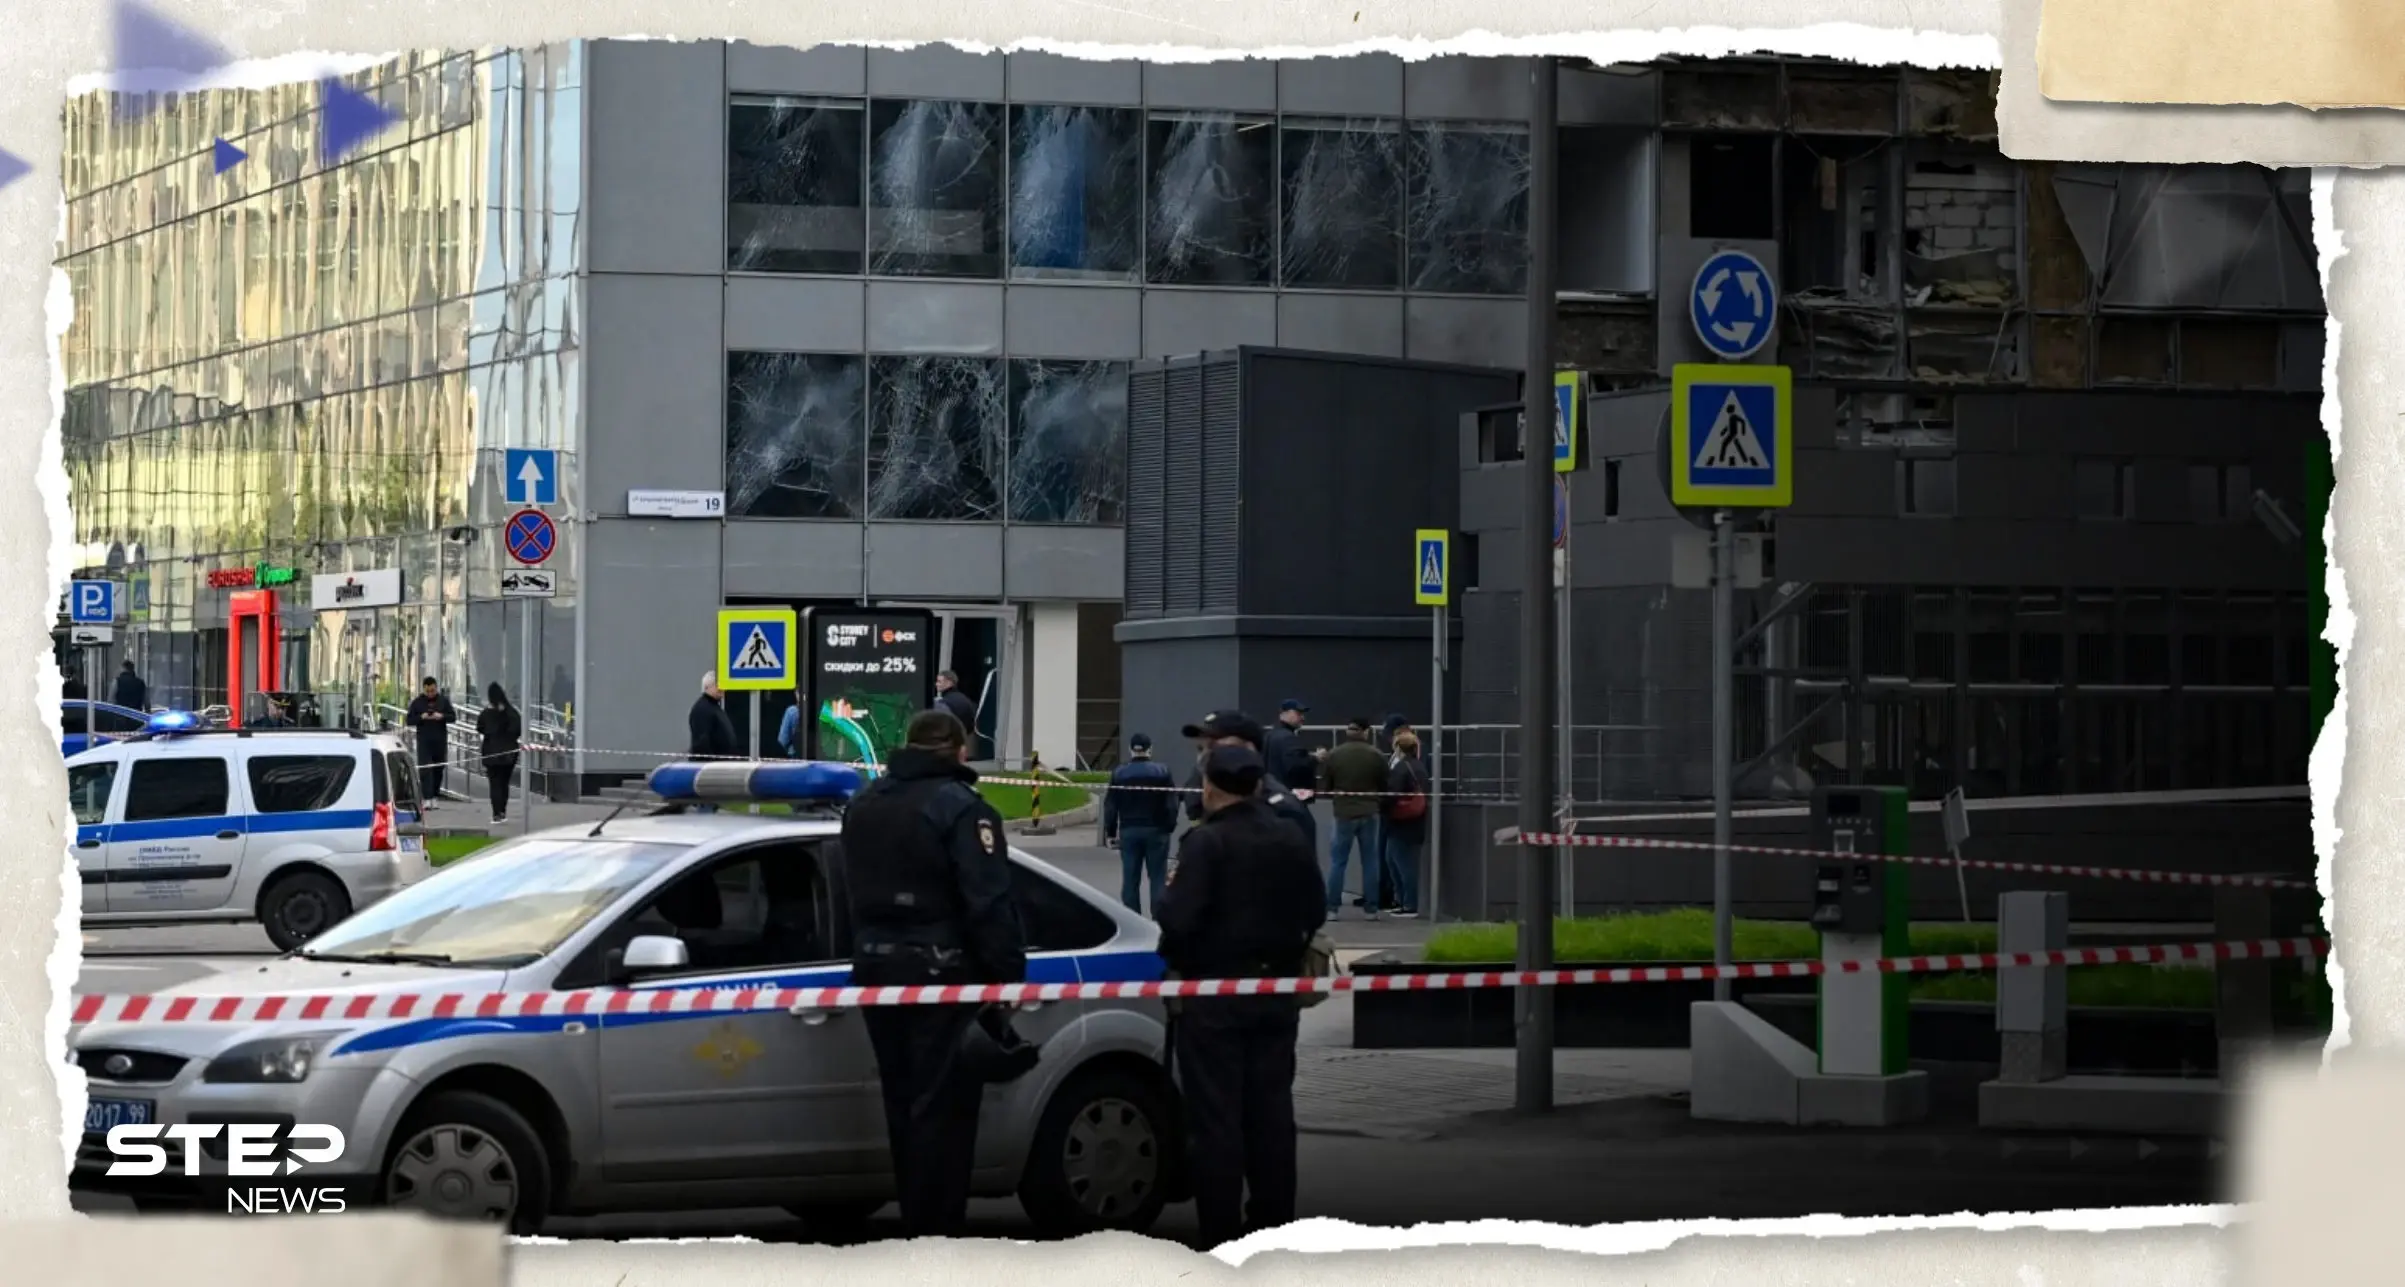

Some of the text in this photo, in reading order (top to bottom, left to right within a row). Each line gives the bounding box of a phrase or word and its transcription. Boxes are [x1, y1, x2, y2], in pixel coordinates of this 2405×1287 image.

[705, 497, 720, 511] 19
[81, 585, 104, 616] P
[840, 637, 857, 646] CITY
[882, 657, 916, 672] 25%
